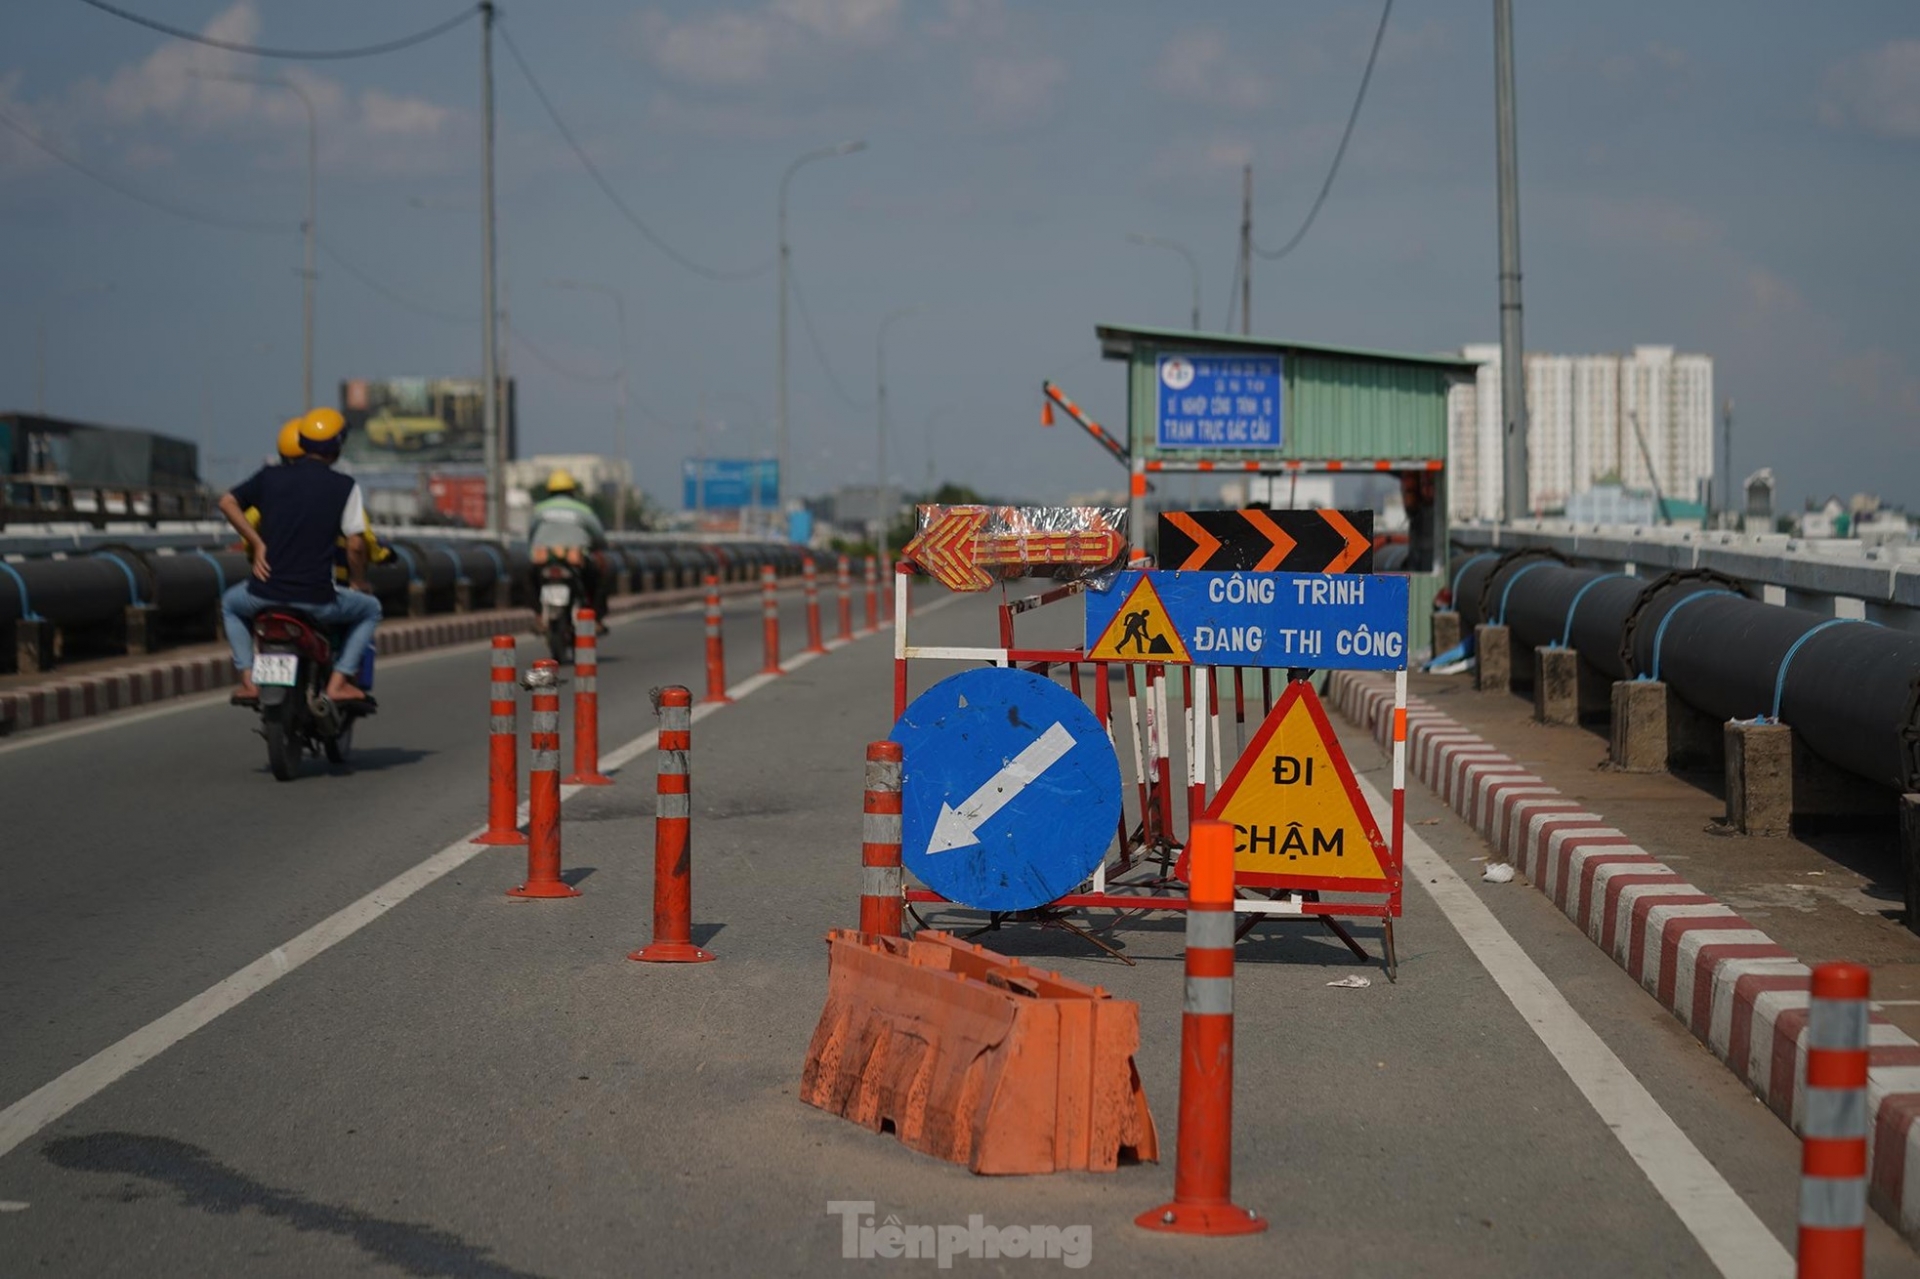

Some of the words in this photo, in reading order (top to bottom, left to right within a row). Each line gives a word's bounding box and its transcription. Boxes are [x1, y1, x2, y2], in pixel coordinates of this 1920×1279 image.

[1208, 572, 1275, 604] CÔNG
[1293, 574, 1365, 605] TRÌNH
[1193, 626, 1263, 653] ĐANG
[1279, 628, 1322, 655] THI
[1336, 623, 1403, 658] CÔNG
[1272, 755, 1313, 786] ĐI
